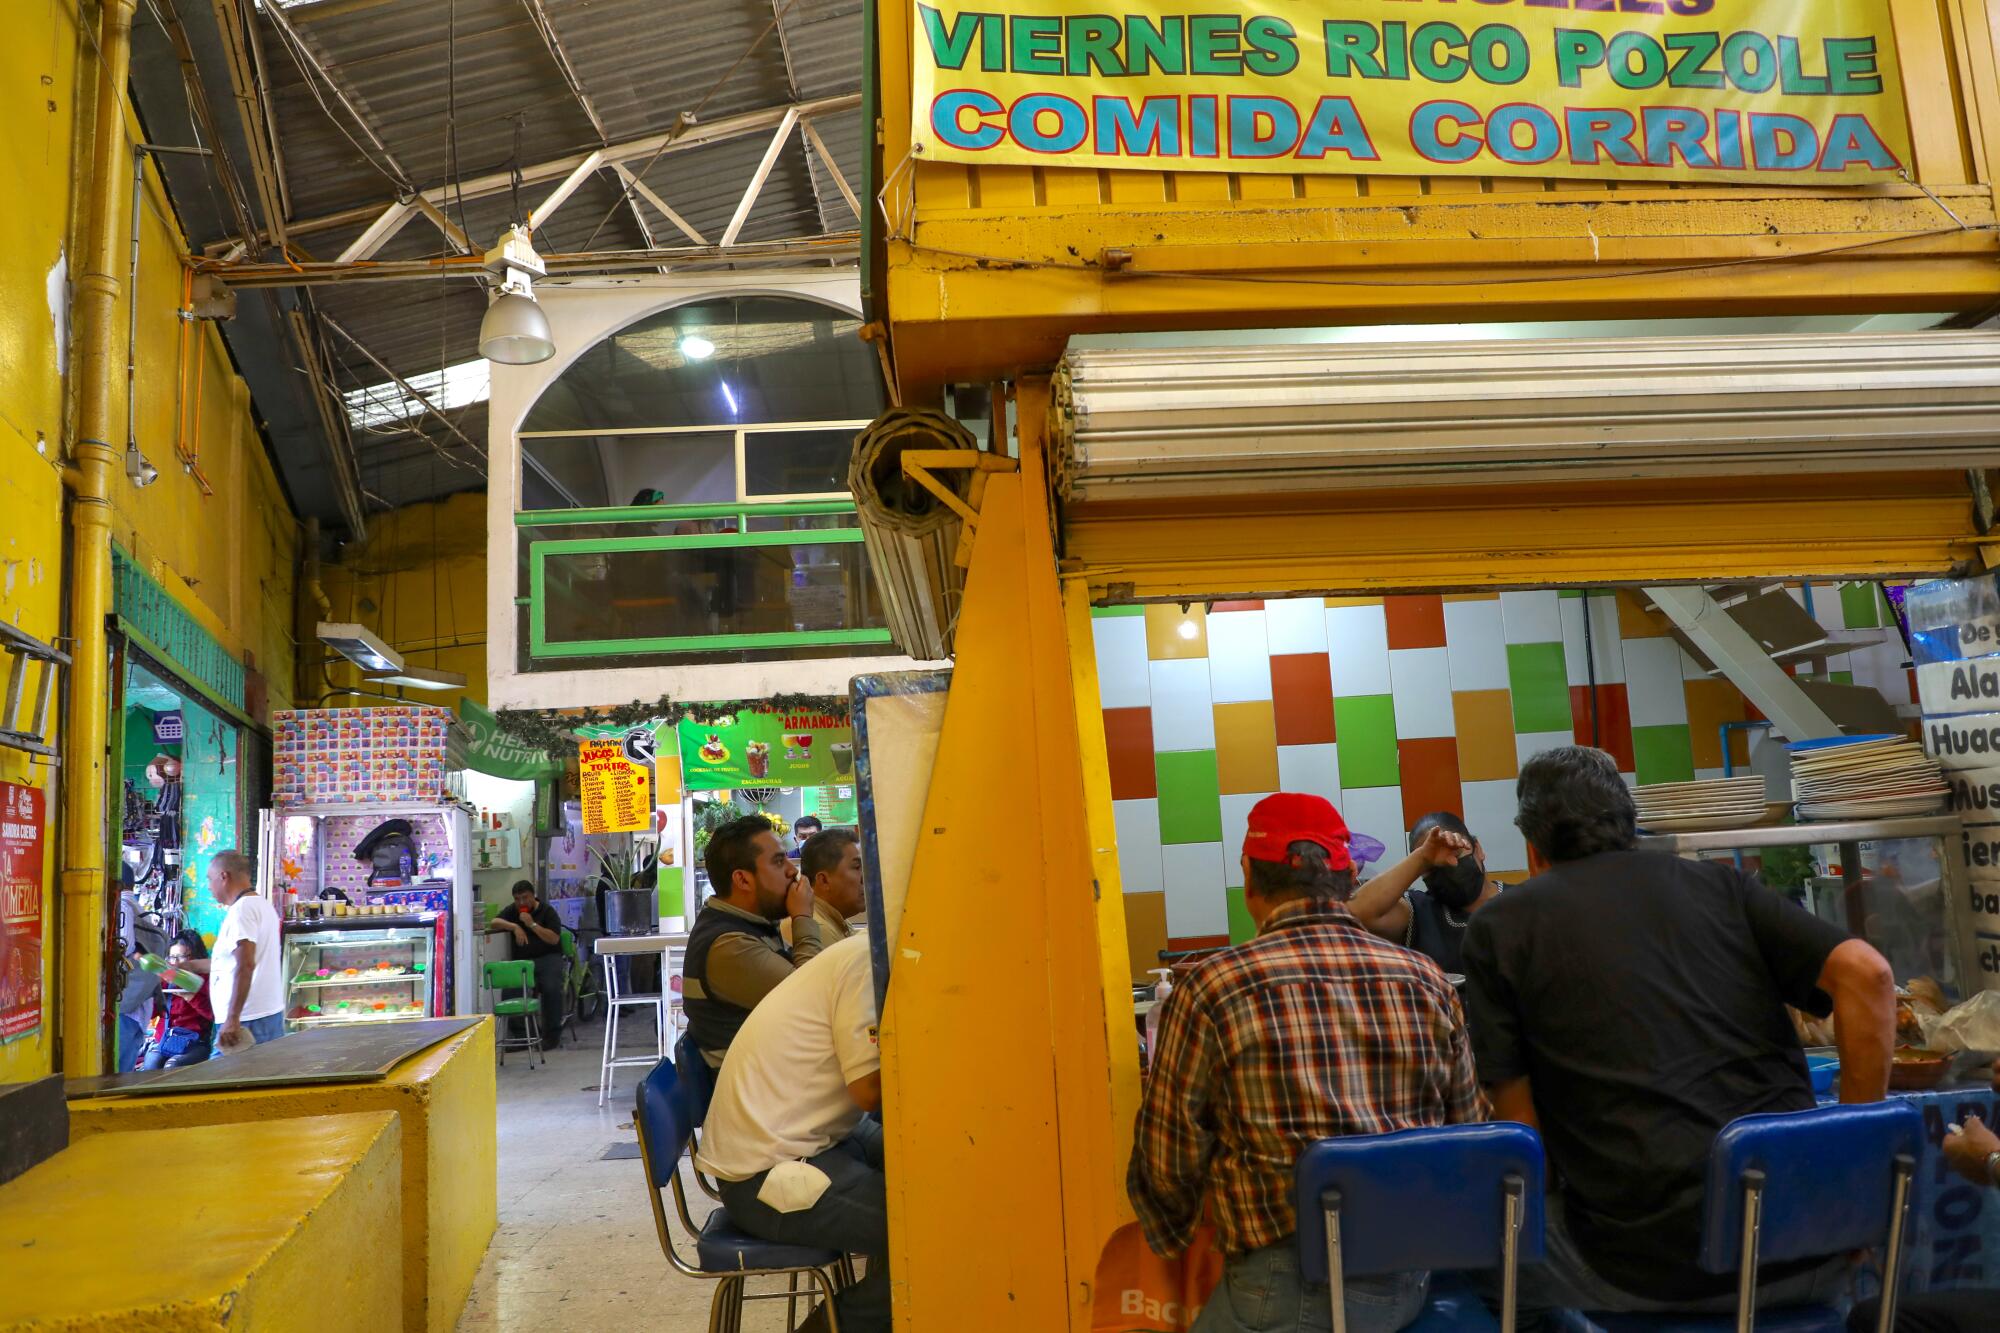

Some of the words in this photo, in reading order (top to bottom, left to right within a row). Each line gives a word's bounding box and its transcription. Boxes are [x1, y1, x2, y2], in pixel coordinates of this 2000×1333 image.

[916, 2, 1300, 77] VIERNES
[1322, 19, 1530, 86] RICO
[1553, 27, 1884, 97] POZOLE
[930, 88, 1382, 162] COMIDA
[1408, 99, 1903, 173] CORRIDA
